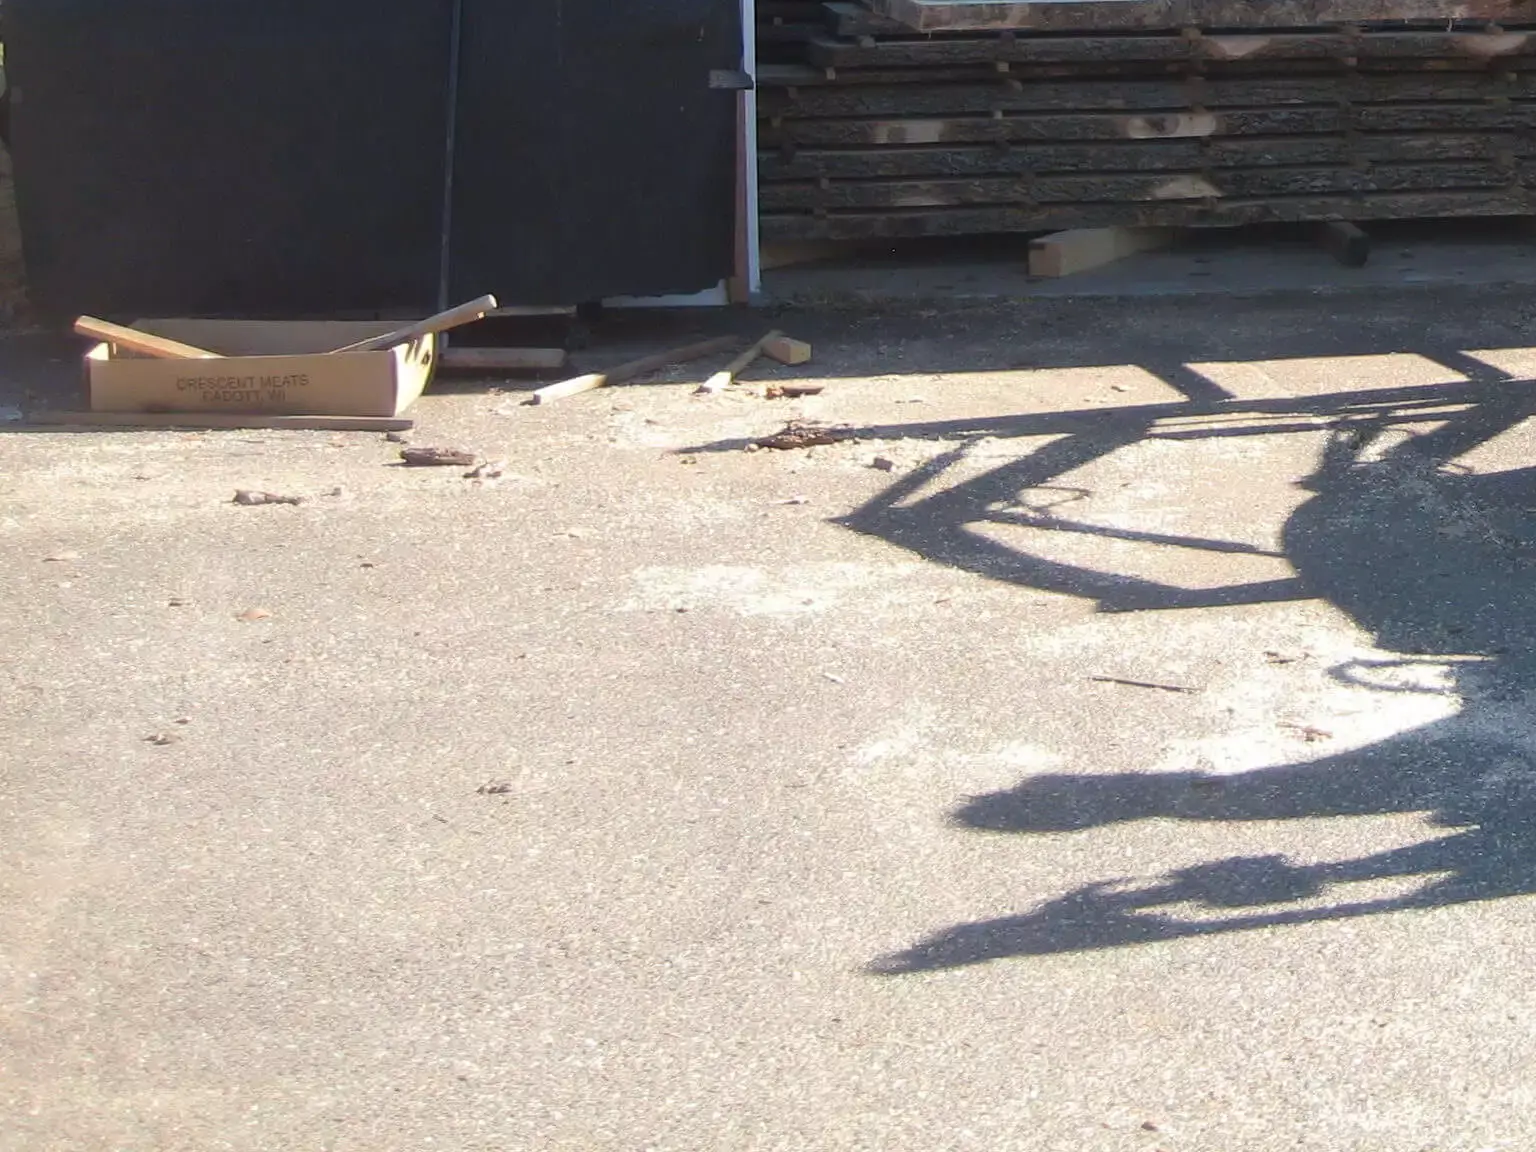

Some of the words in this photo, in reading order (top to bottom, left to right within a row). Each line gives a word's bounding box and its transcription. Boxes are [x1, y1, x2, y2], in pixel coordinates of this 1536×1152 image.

[176, 375, 255, 391] CRESCENT
[259, 373, 310, 389] MEATS
[267, 389, 287, 402] WI
